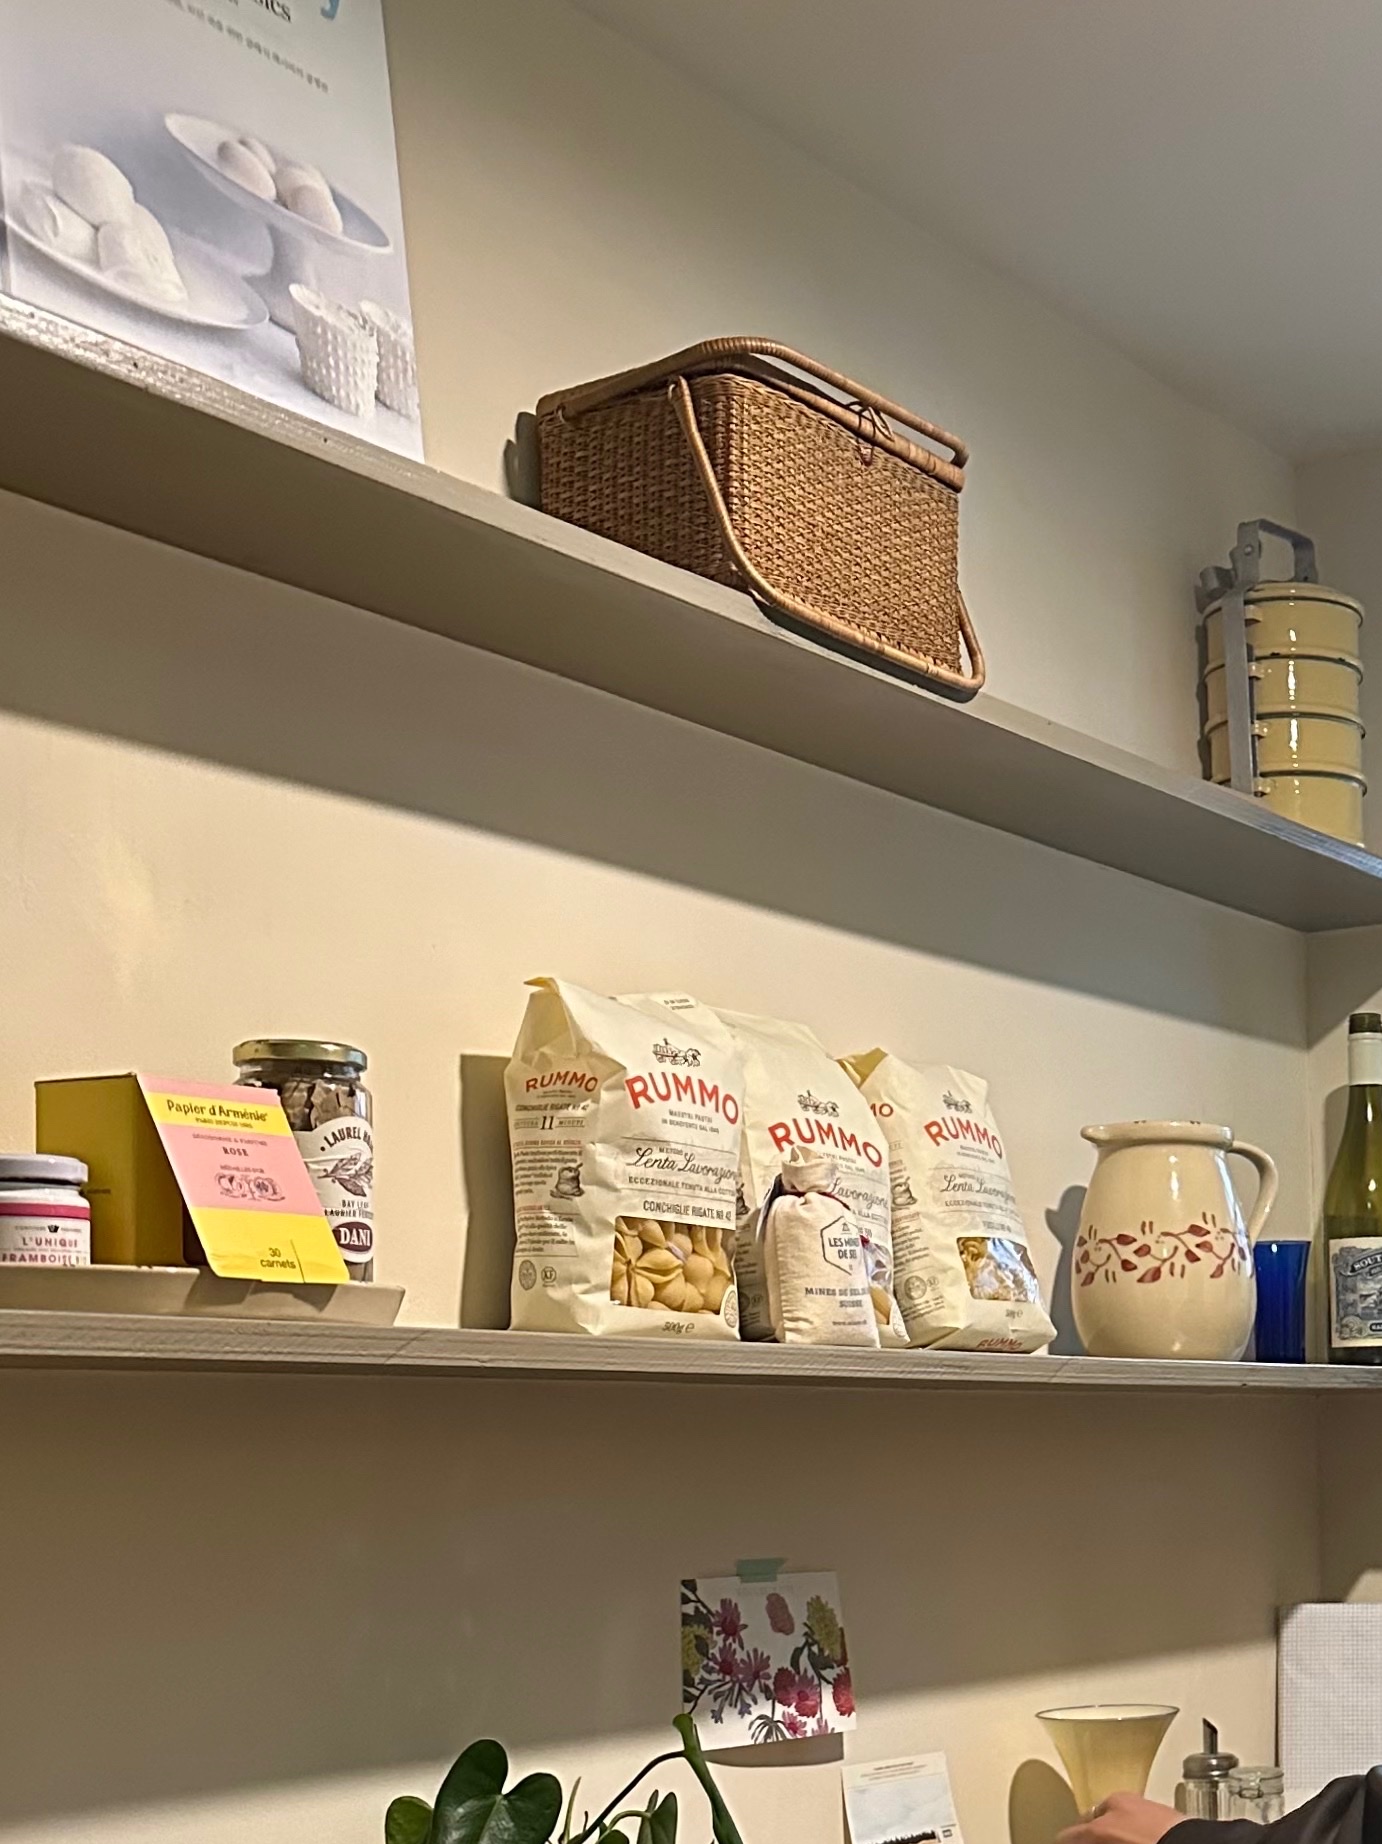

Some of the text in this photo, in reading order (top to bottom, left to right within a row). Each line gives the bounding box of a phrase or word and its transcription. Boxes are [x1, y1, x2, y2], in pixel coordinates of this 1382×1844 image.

[525, 1071, 598, 1093] RUMMO
[625, 1071, 739, 1125] RUMMO
[167, 1099, 206, 1116] Papier
[324, 1126, 361, 1148] LAUREL
[768, 1117, 882, 1168] RUMMO
[924, 1116, 1003, 1159] RUMMO
[222, 1146, 249, 1156] ROSE
[626, 1147, 677, 1171] Lenta
[339, 1227, 371, 1247] DANI
[828, 1237, 844, 1247] LES
[268, 1247, 282, 1258] 30
[838, 1249, 848, 1259] DE
[260, 1258, 296, 1269] carnets
[805, 1287, 837, 1296] MINES
